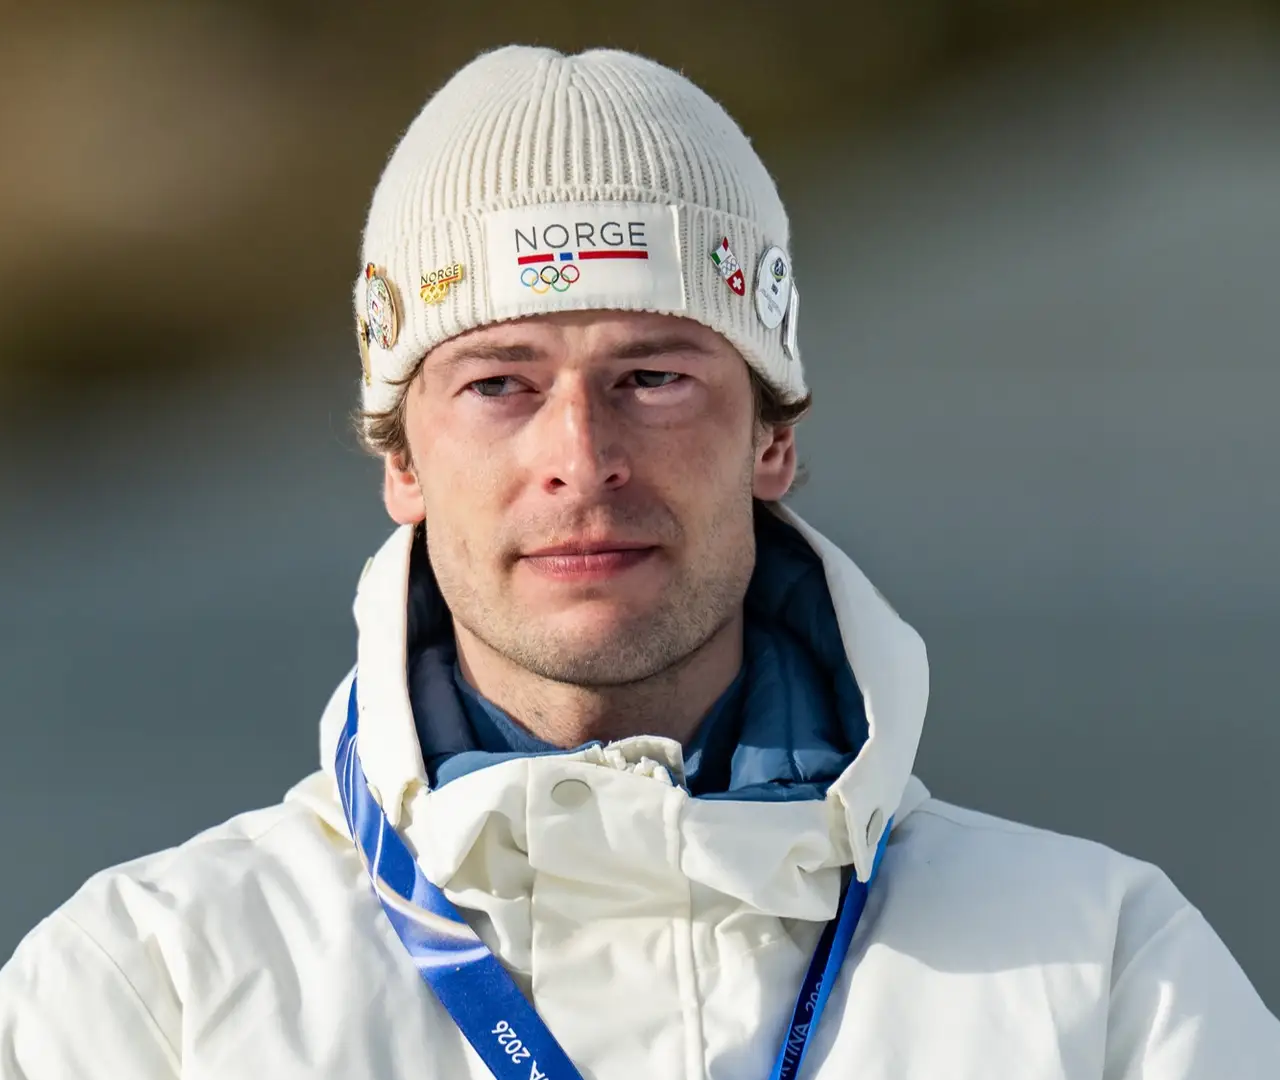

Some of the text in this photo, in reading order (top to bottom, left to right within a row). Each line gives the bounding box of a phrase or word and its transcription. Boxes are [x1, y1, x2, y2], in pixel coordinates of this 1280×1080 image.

[515, 222, 648, 252] NORGE
[421, 264, 459, 285] NORGE
[491, 1020, 531, 1064] 2026
